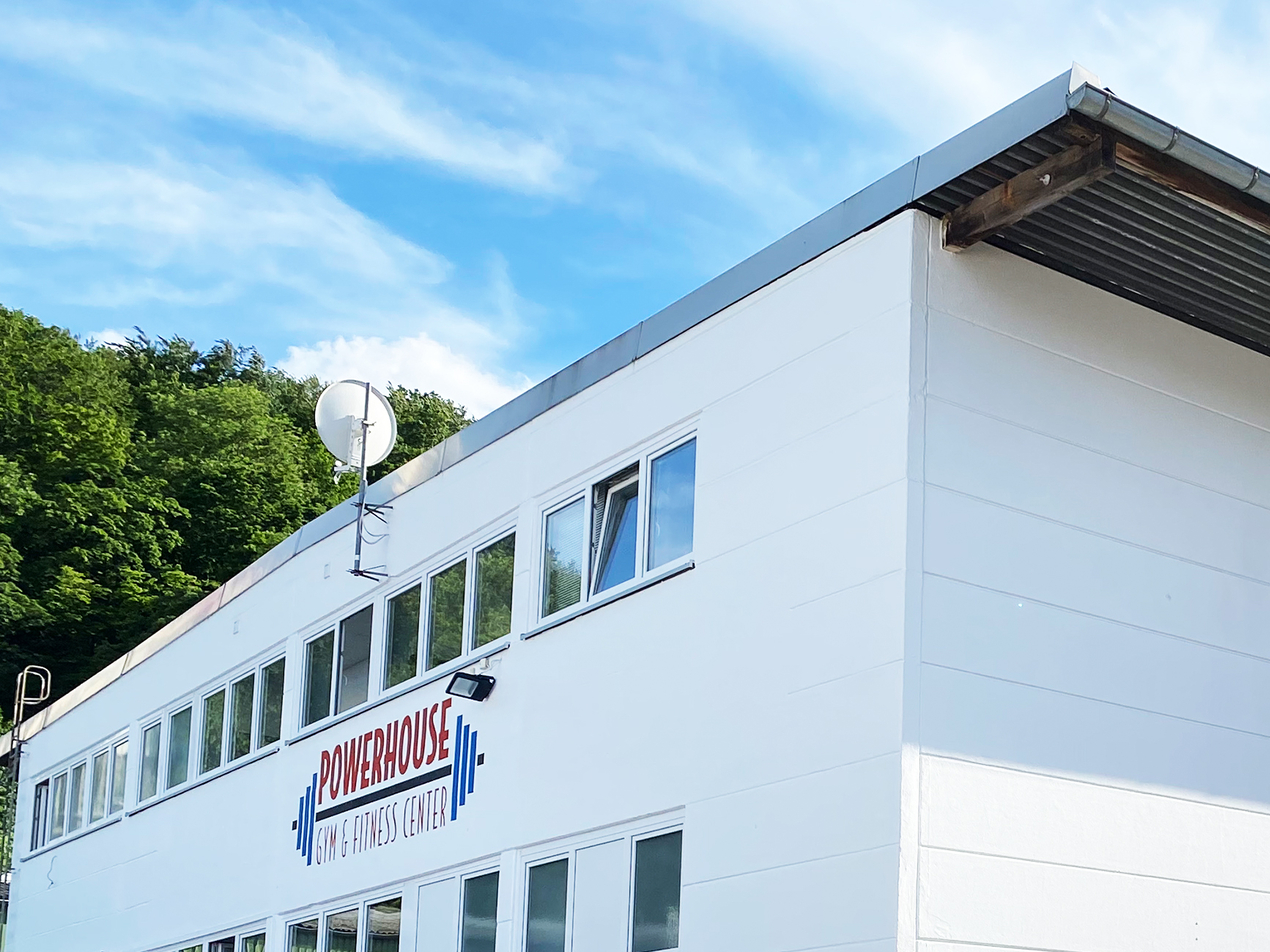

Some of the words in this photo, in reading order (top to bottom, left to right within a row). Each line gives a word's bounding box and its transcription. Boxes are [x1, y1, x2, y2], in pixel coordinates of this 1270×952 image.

[318, 698, 452, 804] POWERHOUSE
[316, 823, 338, 866] GYM
[341, 818, 348, 858] &
[352, 801, 398, 855] FITNESS
[403, 786, 448, 839] CENTER
